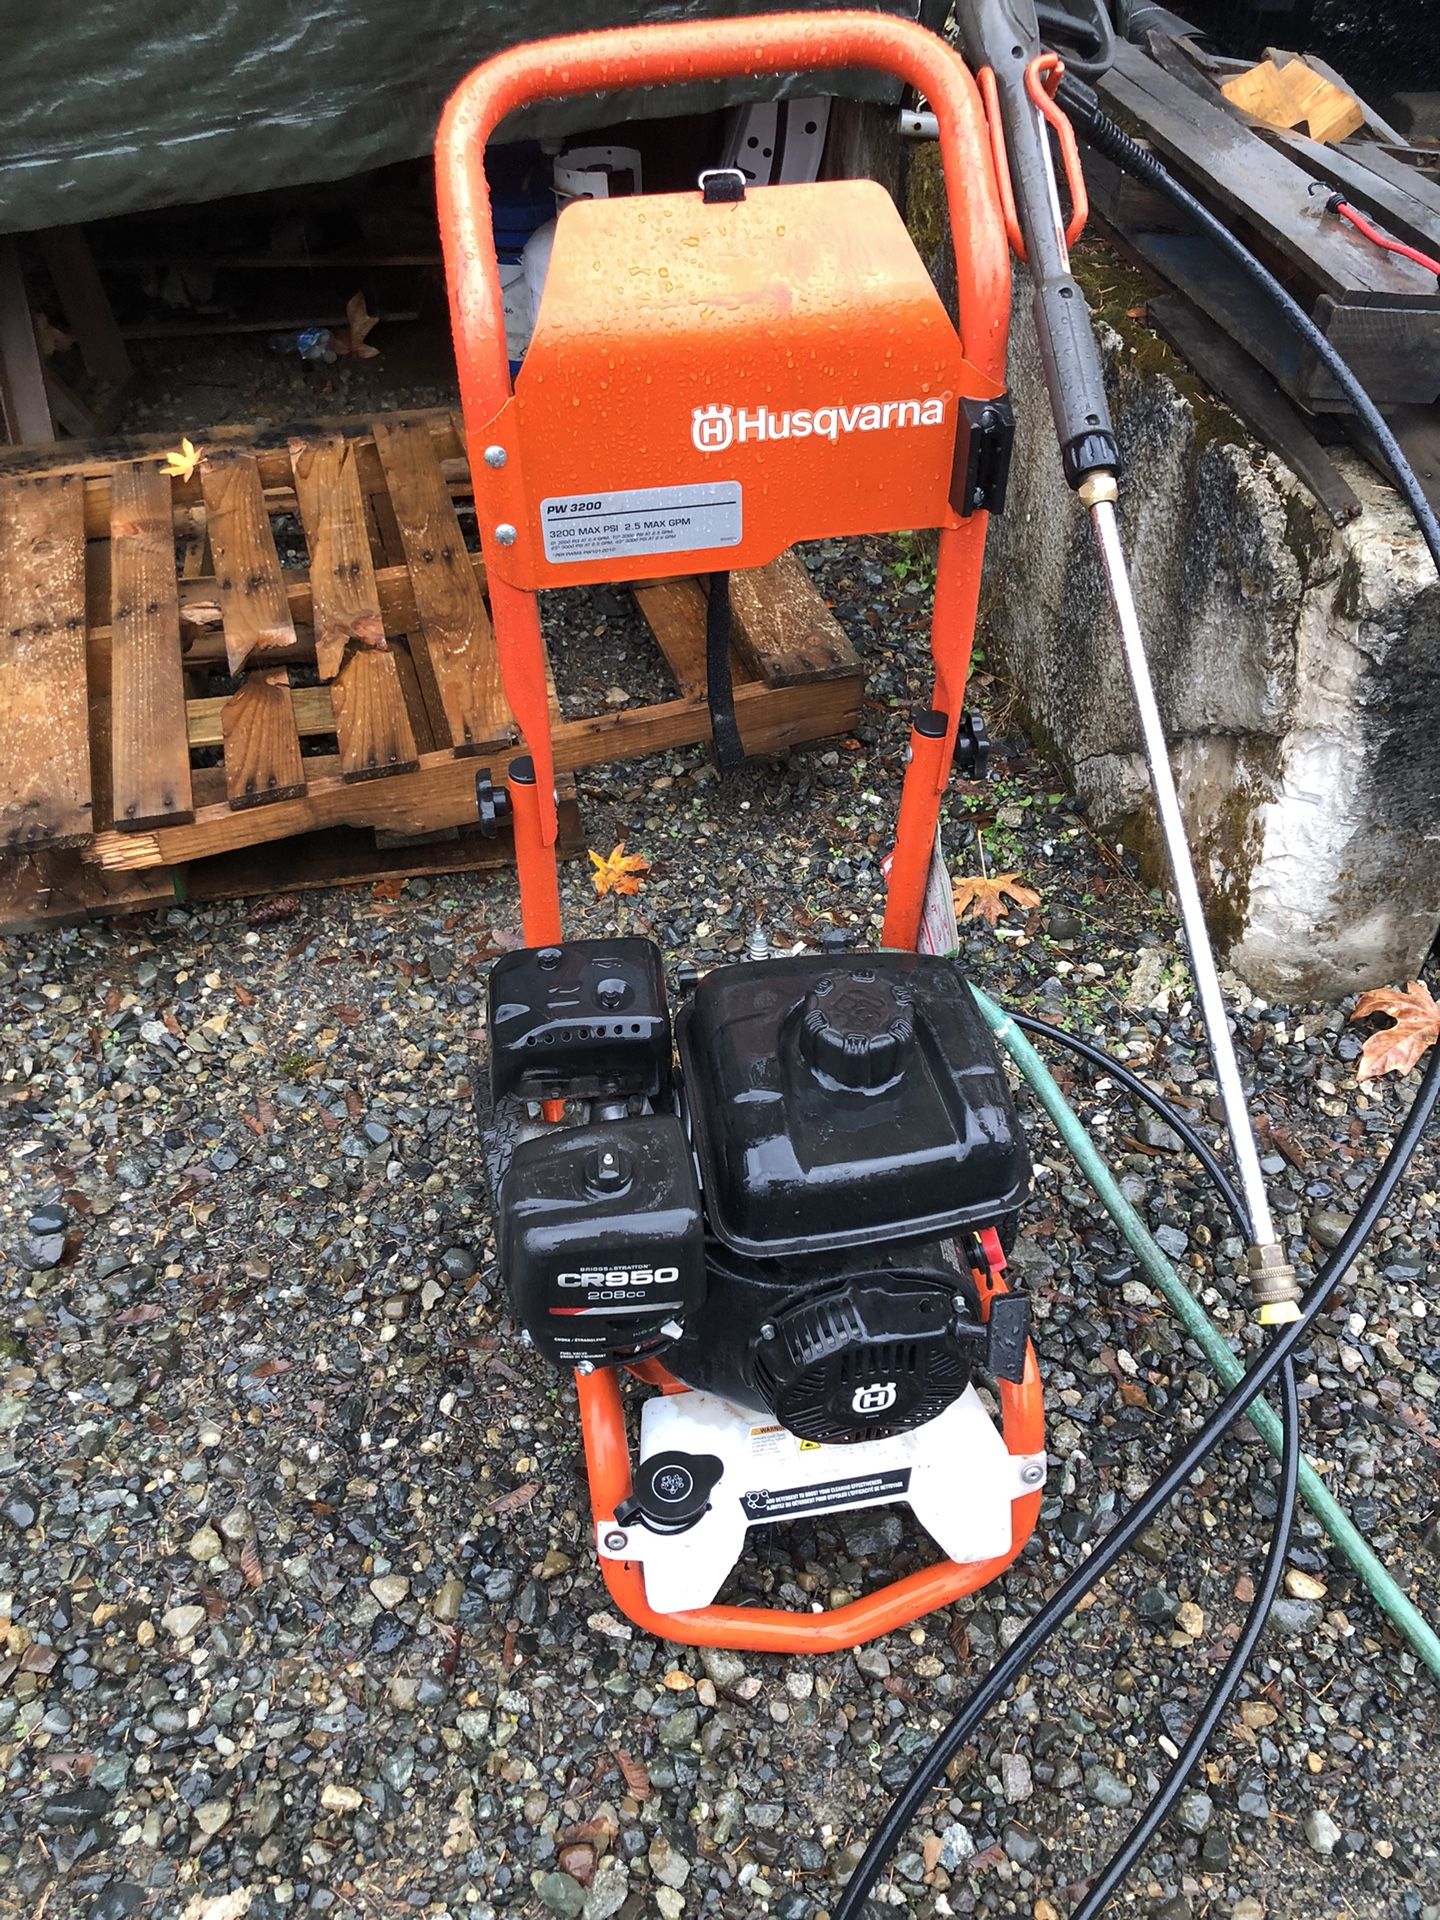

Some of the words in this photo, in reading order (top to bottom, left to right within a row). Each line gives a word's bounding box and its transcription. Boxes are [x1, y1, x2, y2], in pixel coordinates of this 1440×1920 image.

[738, 398, 945, 441] Husqvarna
[547, 504, 568, 514] PW
[570, 501, 602, 512] 3200
[550, 528, 576, 538] 3200
[578, 526, 601, 536] MAX
[604, 524, 619, 533] PSI
[624, 522, 641, 531] 2.5
[644, 520, 666, 529] MAX
[668, 518, 691, 527] GPM
[557, 1266, 680, 1288] CR950
[588, 1290, 646, 1300] 208cc
